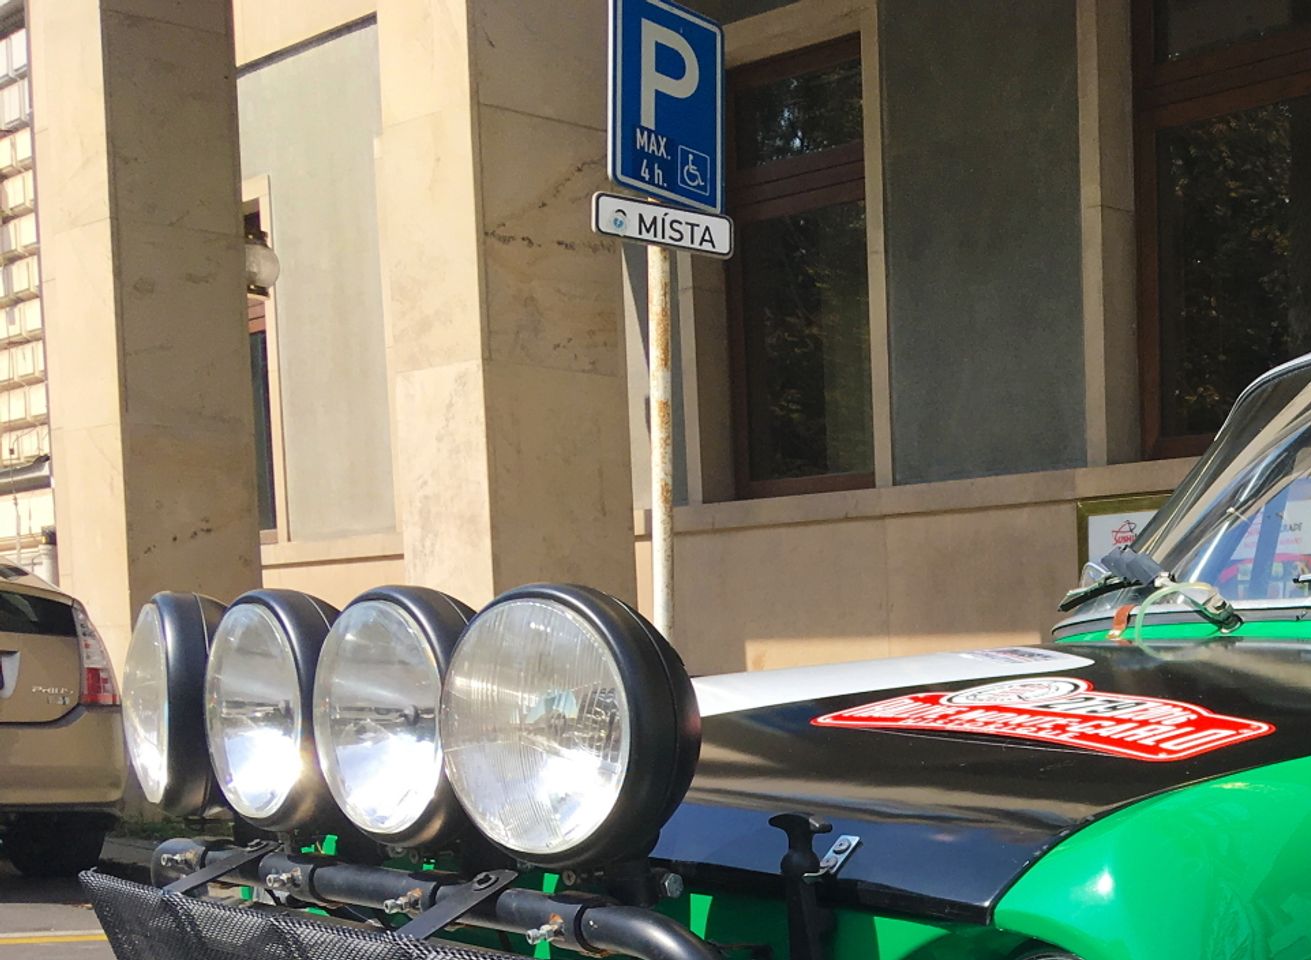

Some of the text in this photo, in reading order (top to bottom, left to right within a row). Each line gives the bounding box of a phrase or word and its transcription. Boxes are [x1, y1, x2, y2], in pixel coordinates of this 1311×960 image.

[640, 18, 700, 130] P
[640, 159, 650, 182] 4
[638, 212, 716, 249] MÍSTA
[1034, 697, 1146, 714] 279
